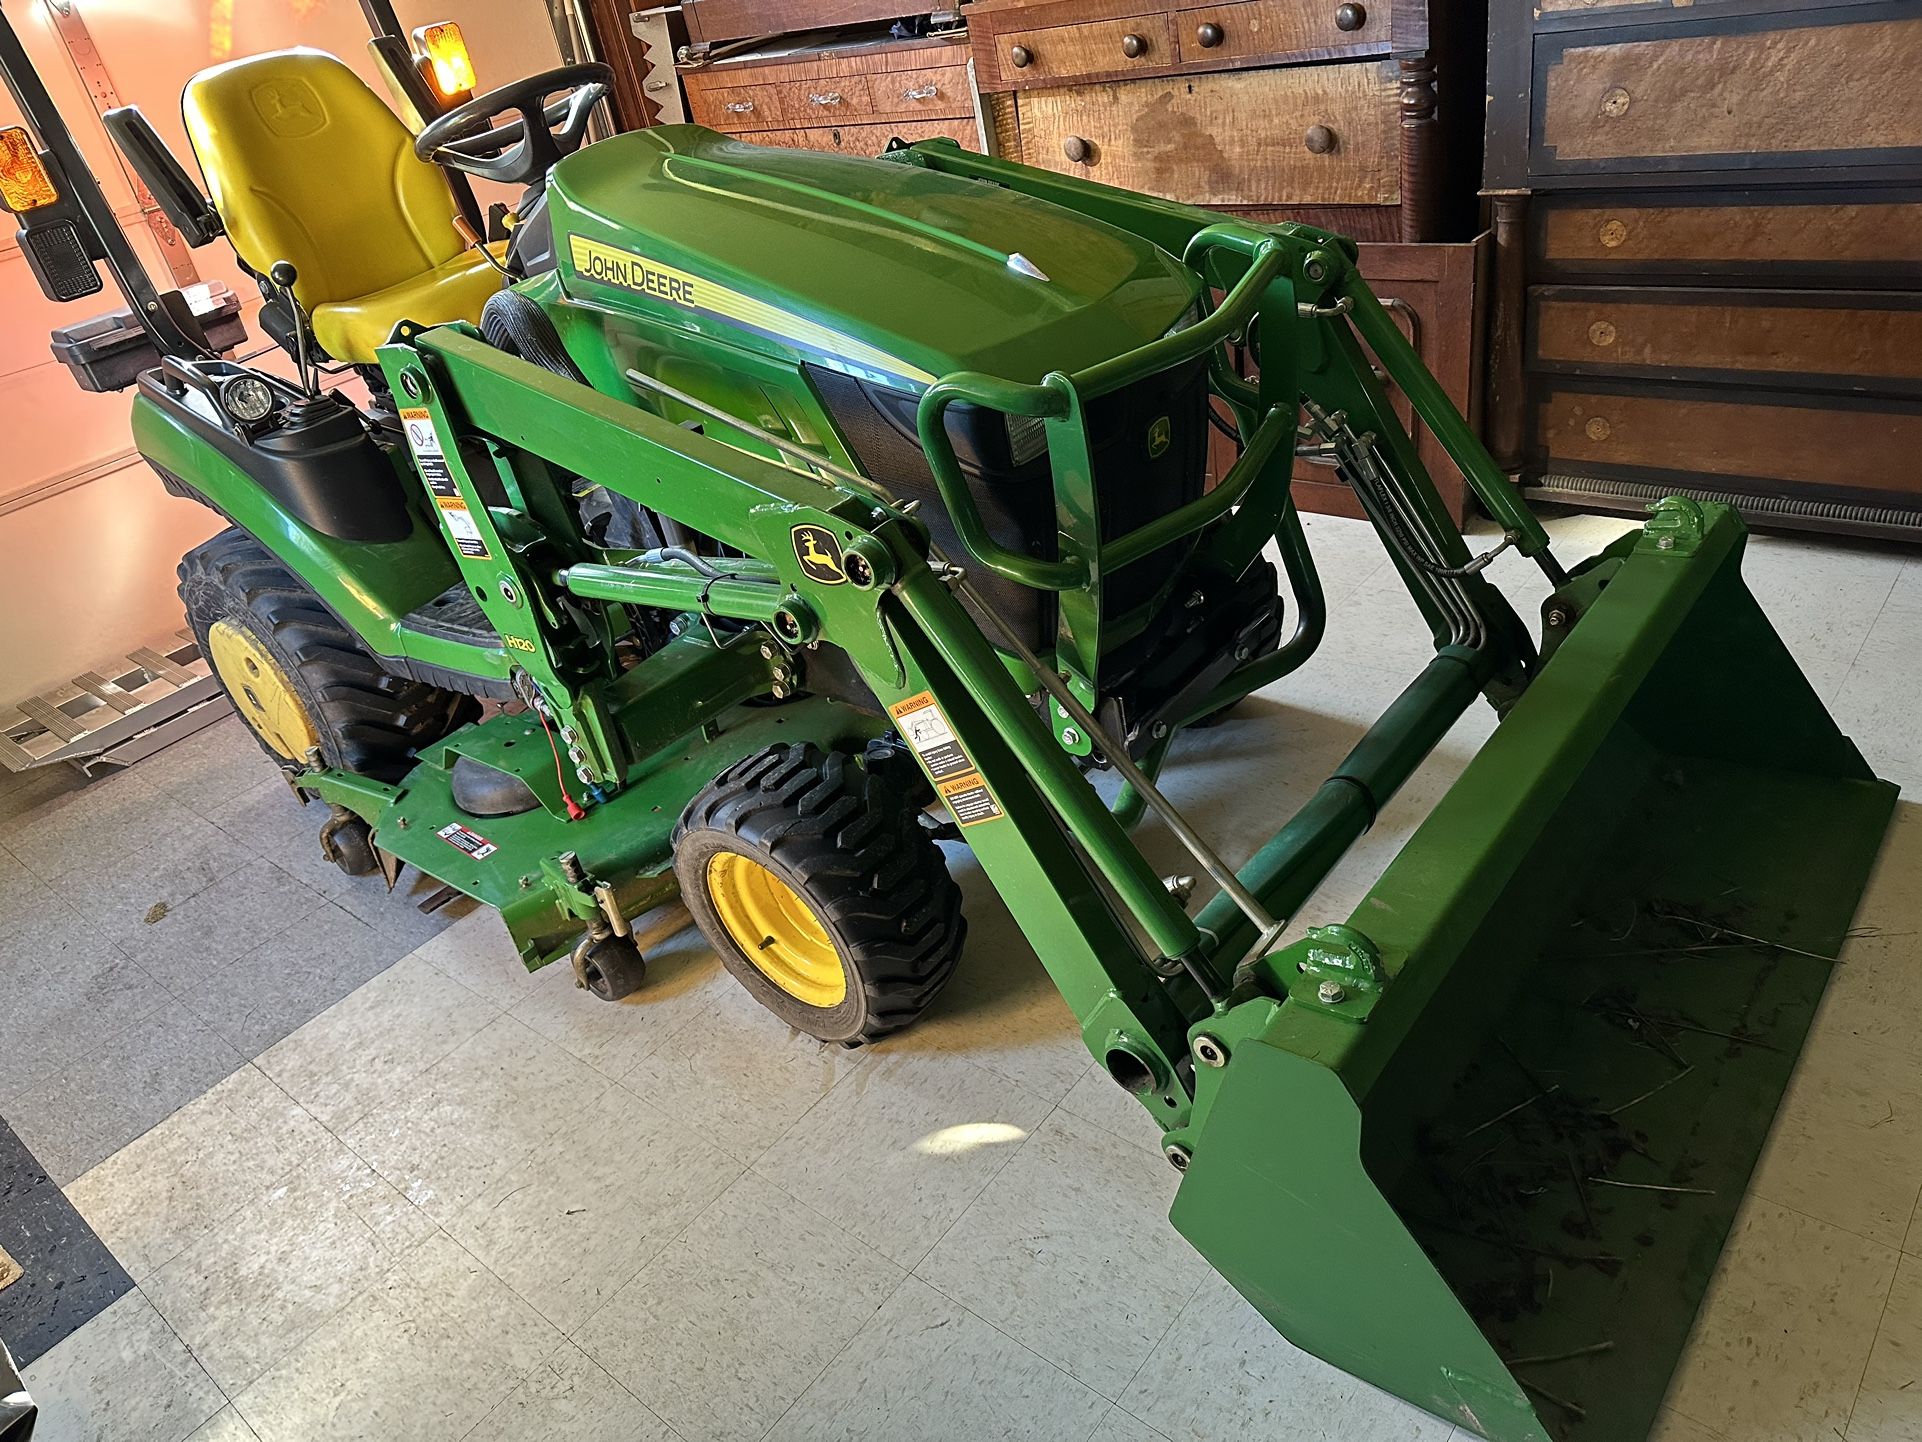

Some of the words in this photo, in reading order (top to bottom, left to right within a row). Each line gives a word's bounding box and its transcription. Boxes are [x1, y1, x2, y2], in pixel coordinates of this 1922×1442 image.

[584, 249, 628, 284] JOHN
[631, 260, 695, 305] DEERE
[902, 696, 929, 713] WARNING
[952, 777, 980, 792] WARNING
